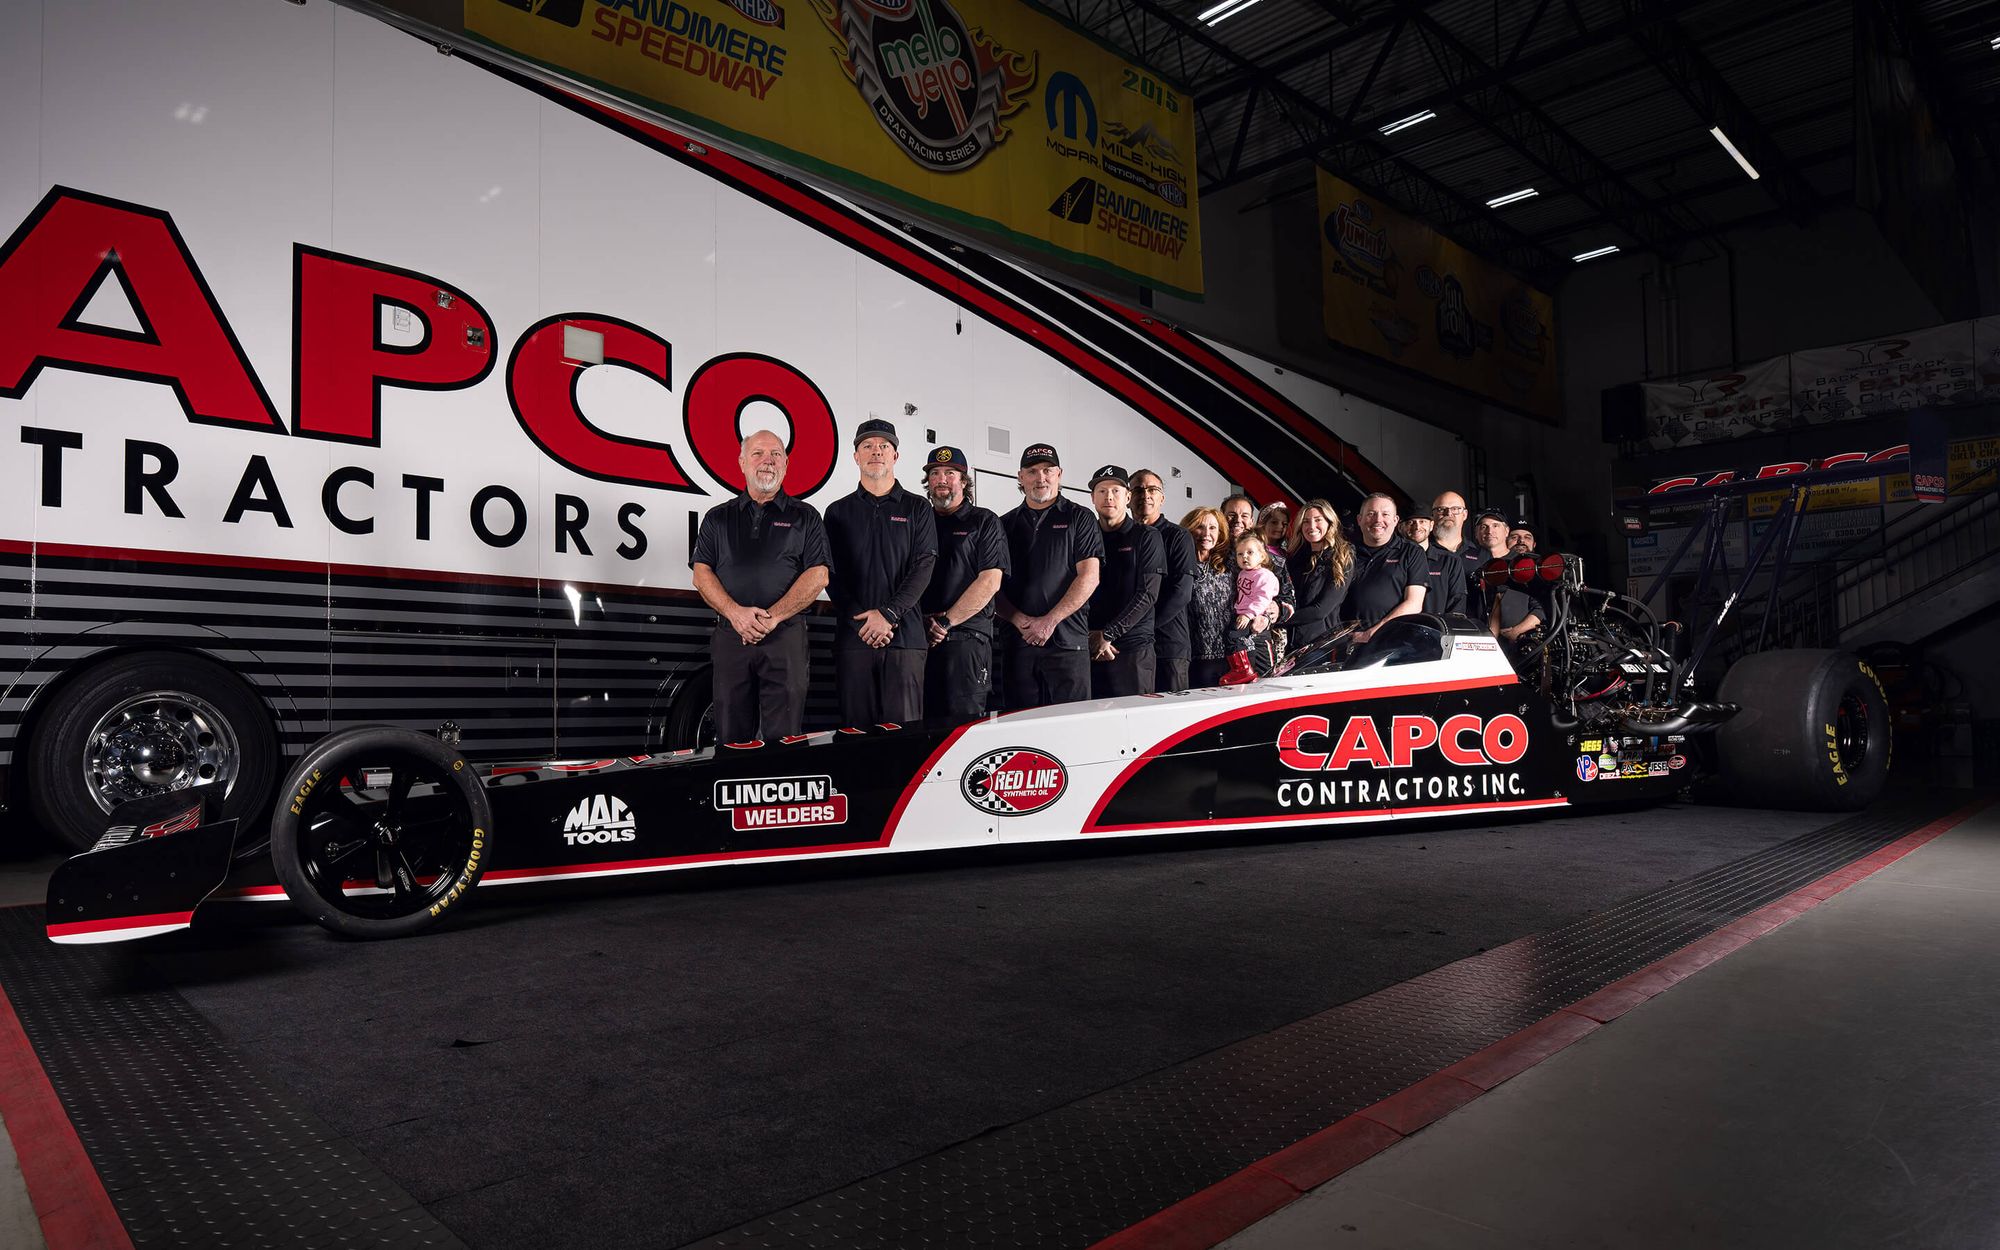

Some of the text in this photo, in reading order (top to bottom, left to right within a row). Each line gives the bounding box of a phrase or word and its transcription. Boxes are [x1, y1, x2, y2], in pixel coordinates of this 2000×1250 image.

[592, 7, 777, 100] SPEEDWAY
[1122, 68, 1179, 114] 2015
[879, 105, 976, 162] DRAG RACING SERIES
[1096, 183, 1189, 242] BANDIMERE
[1096, 208, 1184, 261] SPEEDWAY
[1027, 448, 1053, 456] CAPCO
[20, 425, 649, 561] TRACTORS
[1914, 474, 1946, 488] CAPCO
[1276, 713, 1529, 771] CAPCO
[1581, 740, 1603, 752] JEGS
[1825, 723, 1849, 786] EAGLE
[290, 768, 323, 817] EAGLE
[721, 781, 826, 806] LINCOLN
[994, 768, 1060, 791] RED LINE
[1002, 789, 1037, 798] SYNTHETIC
[1277, 773, 1525, 807] CONTRACTORS INC.
[564, 794, 636, 831] MAC
[745, 805, 836, 827] WELDERS
[563, 828, 637, 846] TOOLS
[429, 827, 486, 918] GOODYEAR
